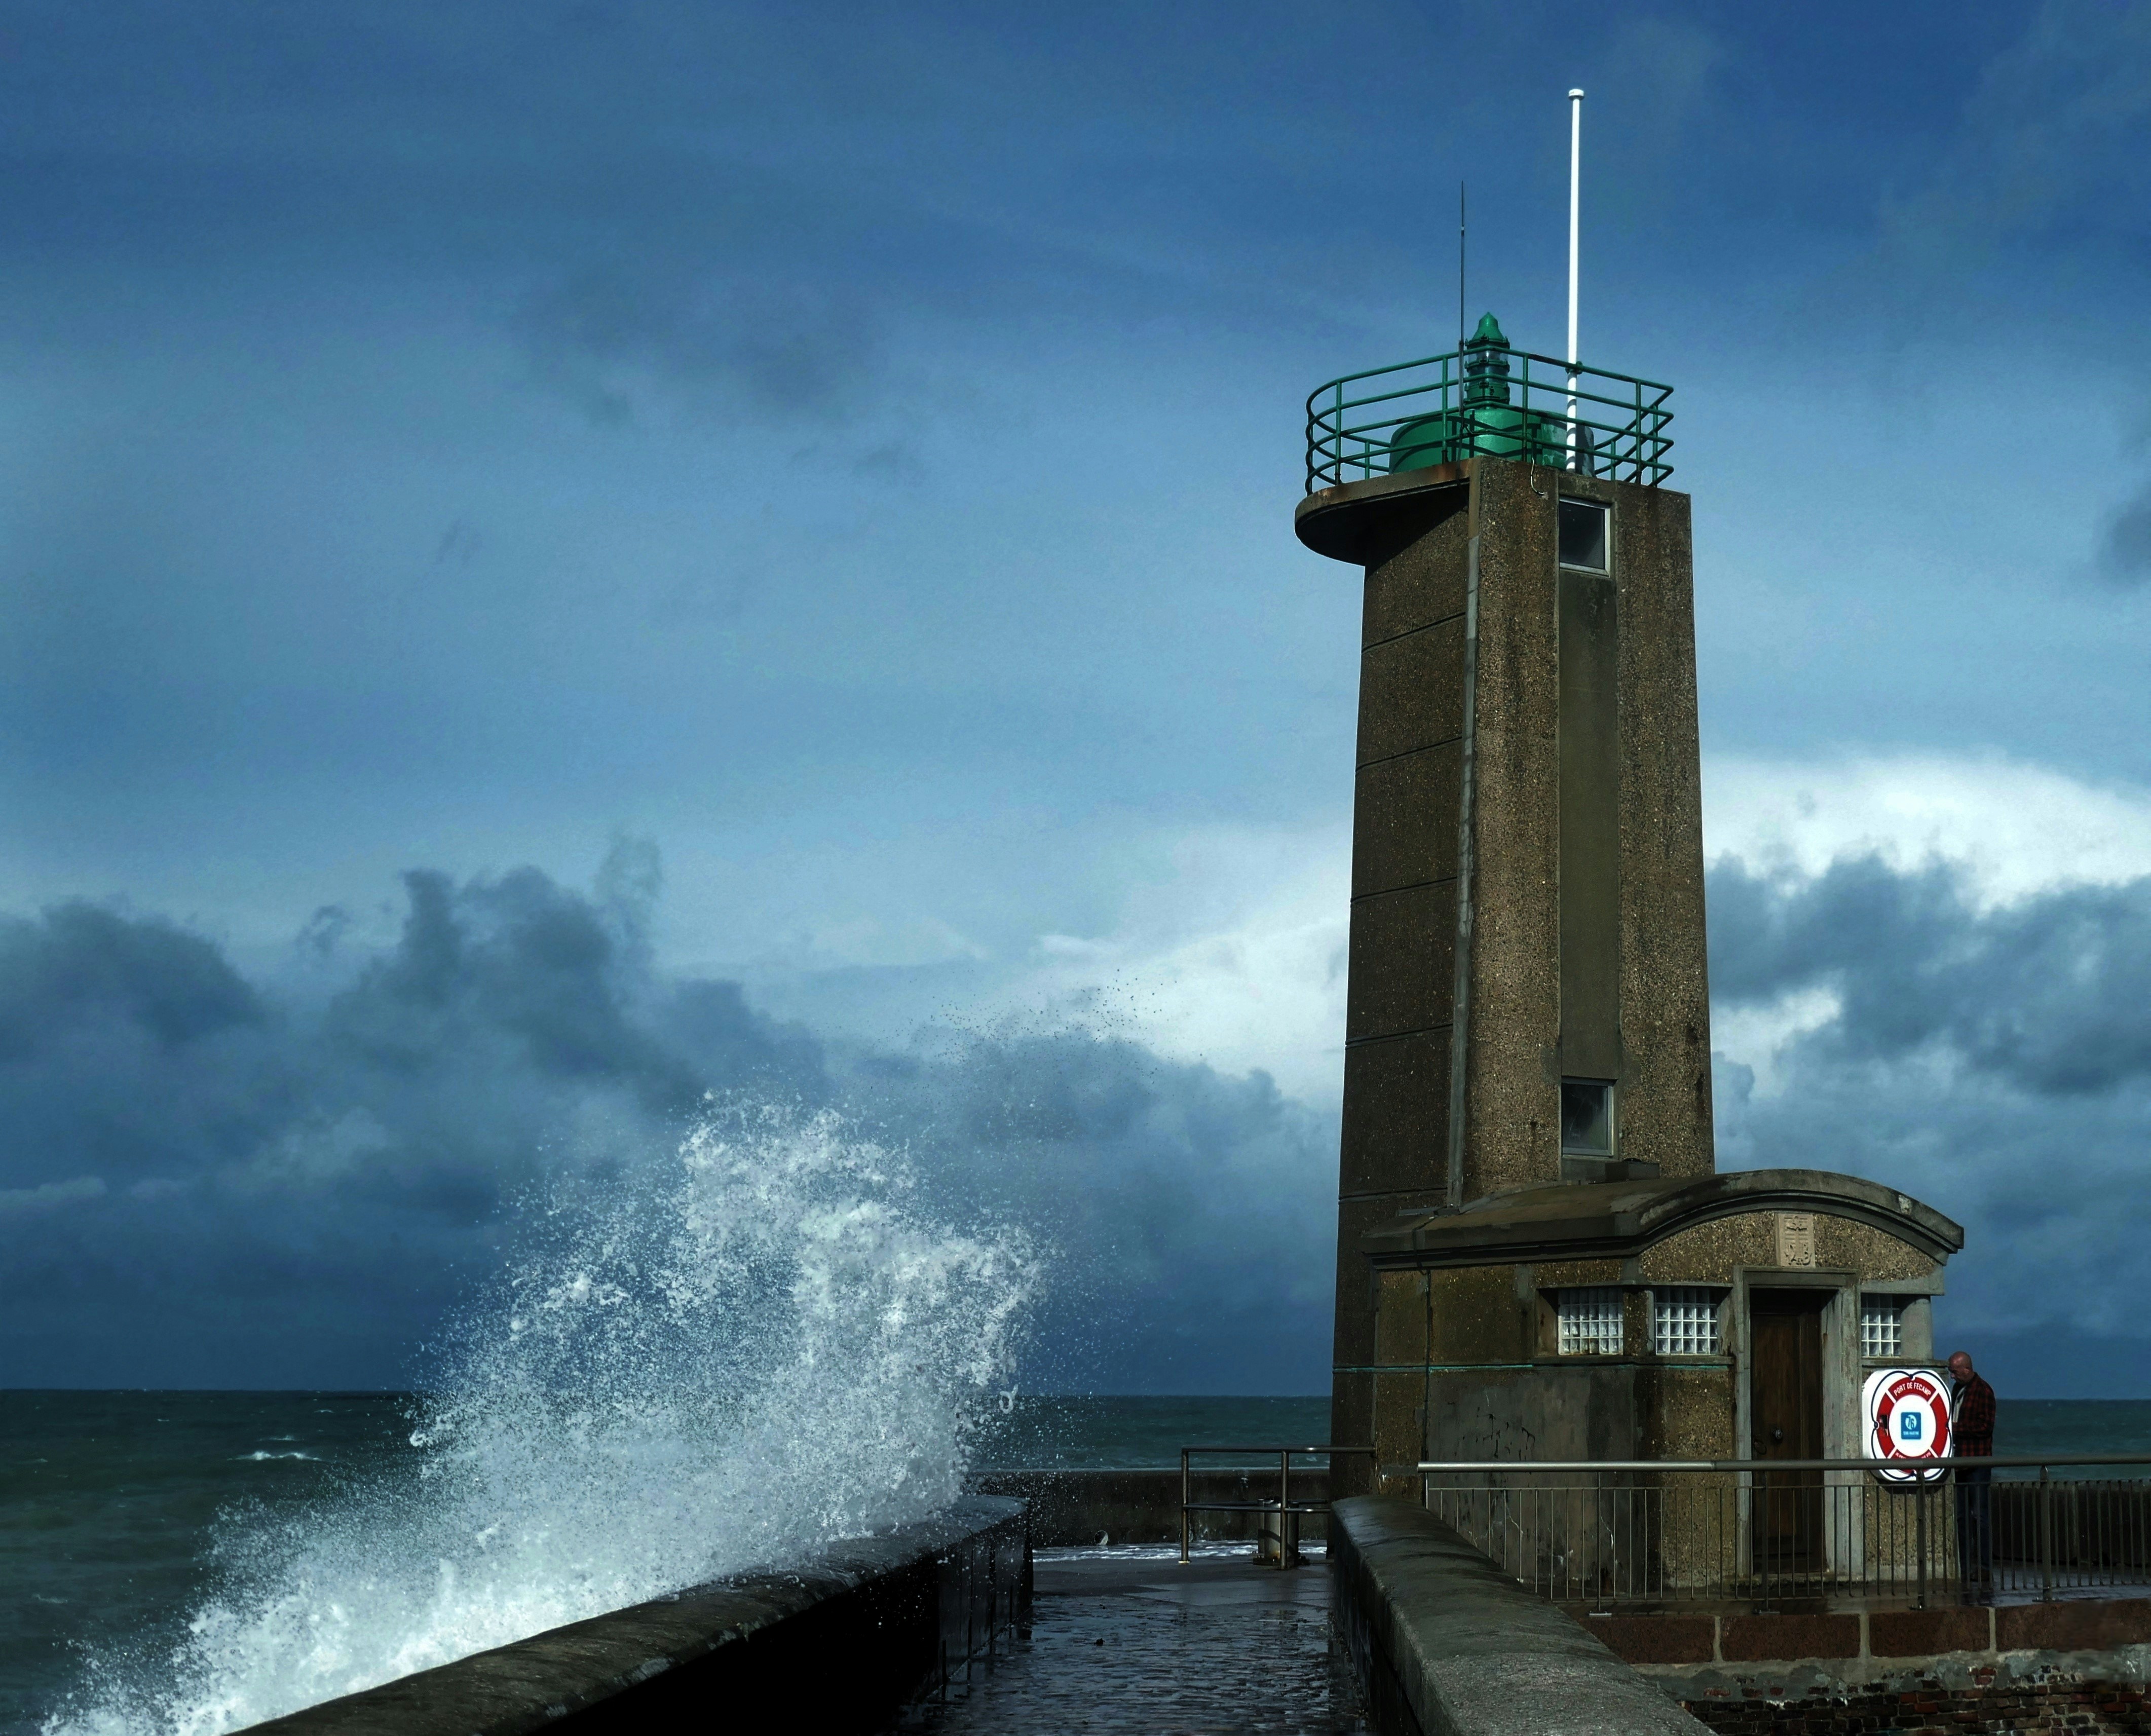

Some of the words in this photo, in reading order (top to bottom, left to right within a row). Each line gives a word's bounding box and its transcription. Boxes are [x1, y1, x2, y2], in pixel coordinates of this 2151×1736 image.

[1893, 1383, 1906, 1397] PORT
[1913, 1382, 1932, 1396] FECAMP
[1906, 1416, 1915, 1429] 76
